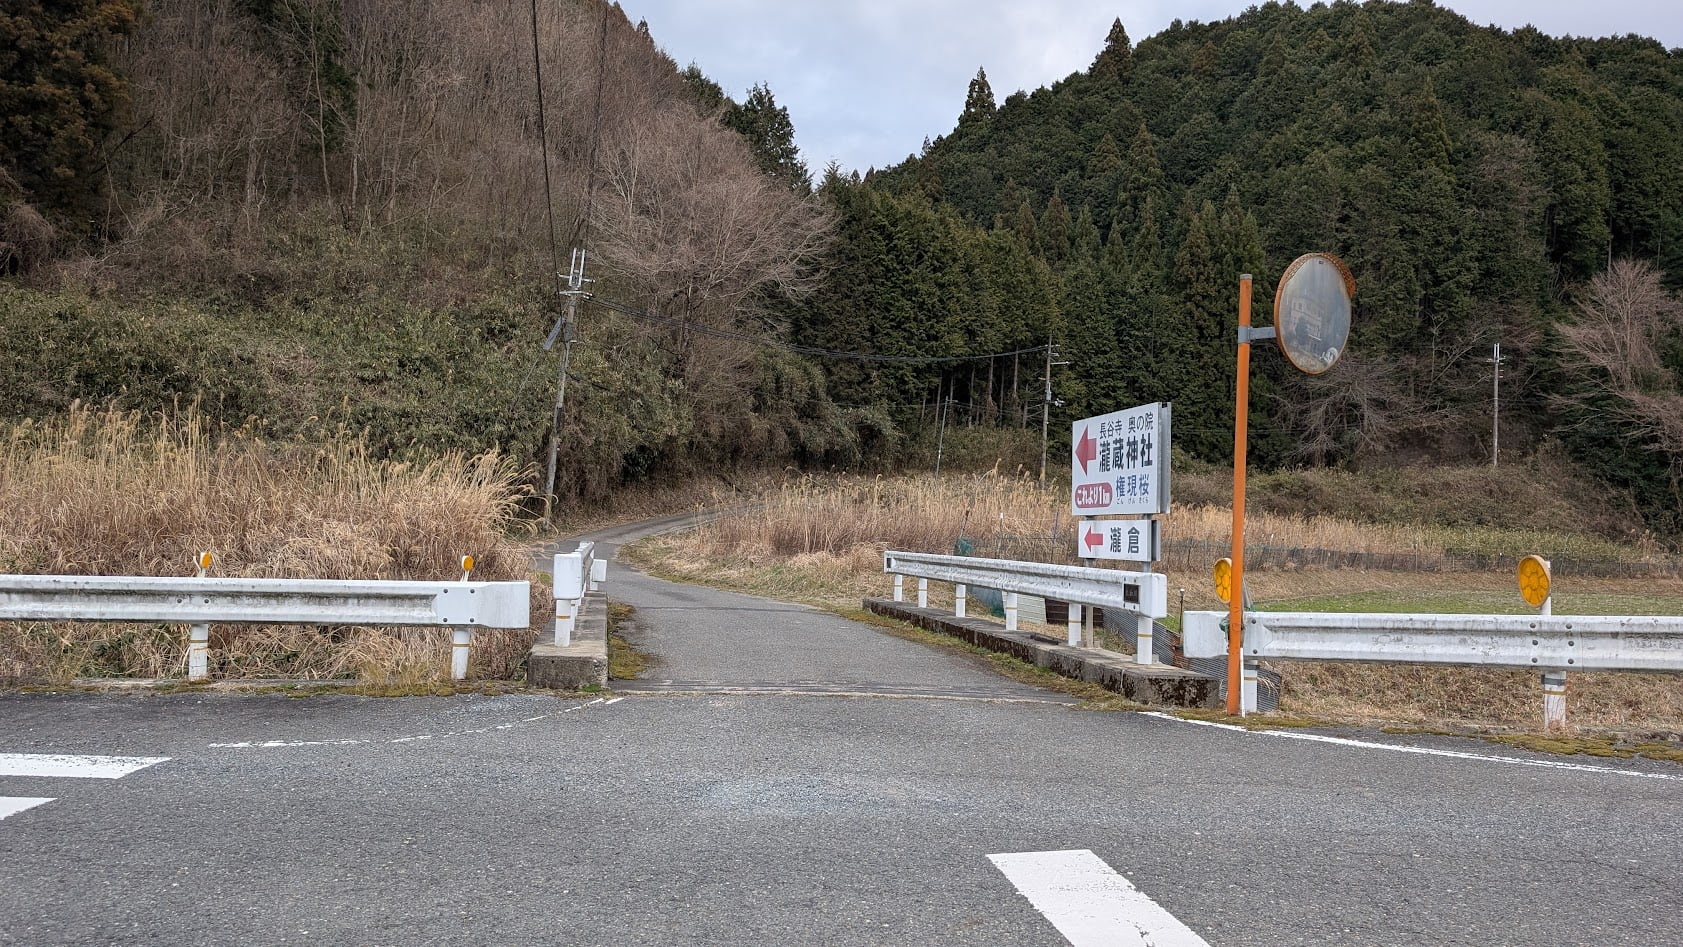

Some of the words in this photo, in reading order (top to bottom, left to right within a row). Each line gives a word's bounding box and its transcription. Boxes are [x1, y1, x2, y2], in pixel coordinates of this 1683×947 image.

[1099, 418, 1123, 440] 長谷寺
[1128, 411, 1154, 434] 奥の院
[1099, 432, 1153, 473] 瀧蔵神社
[1115, 473, 1149, 497] 権現桜
[1110, 526, 1140, 554] 瀧倉
